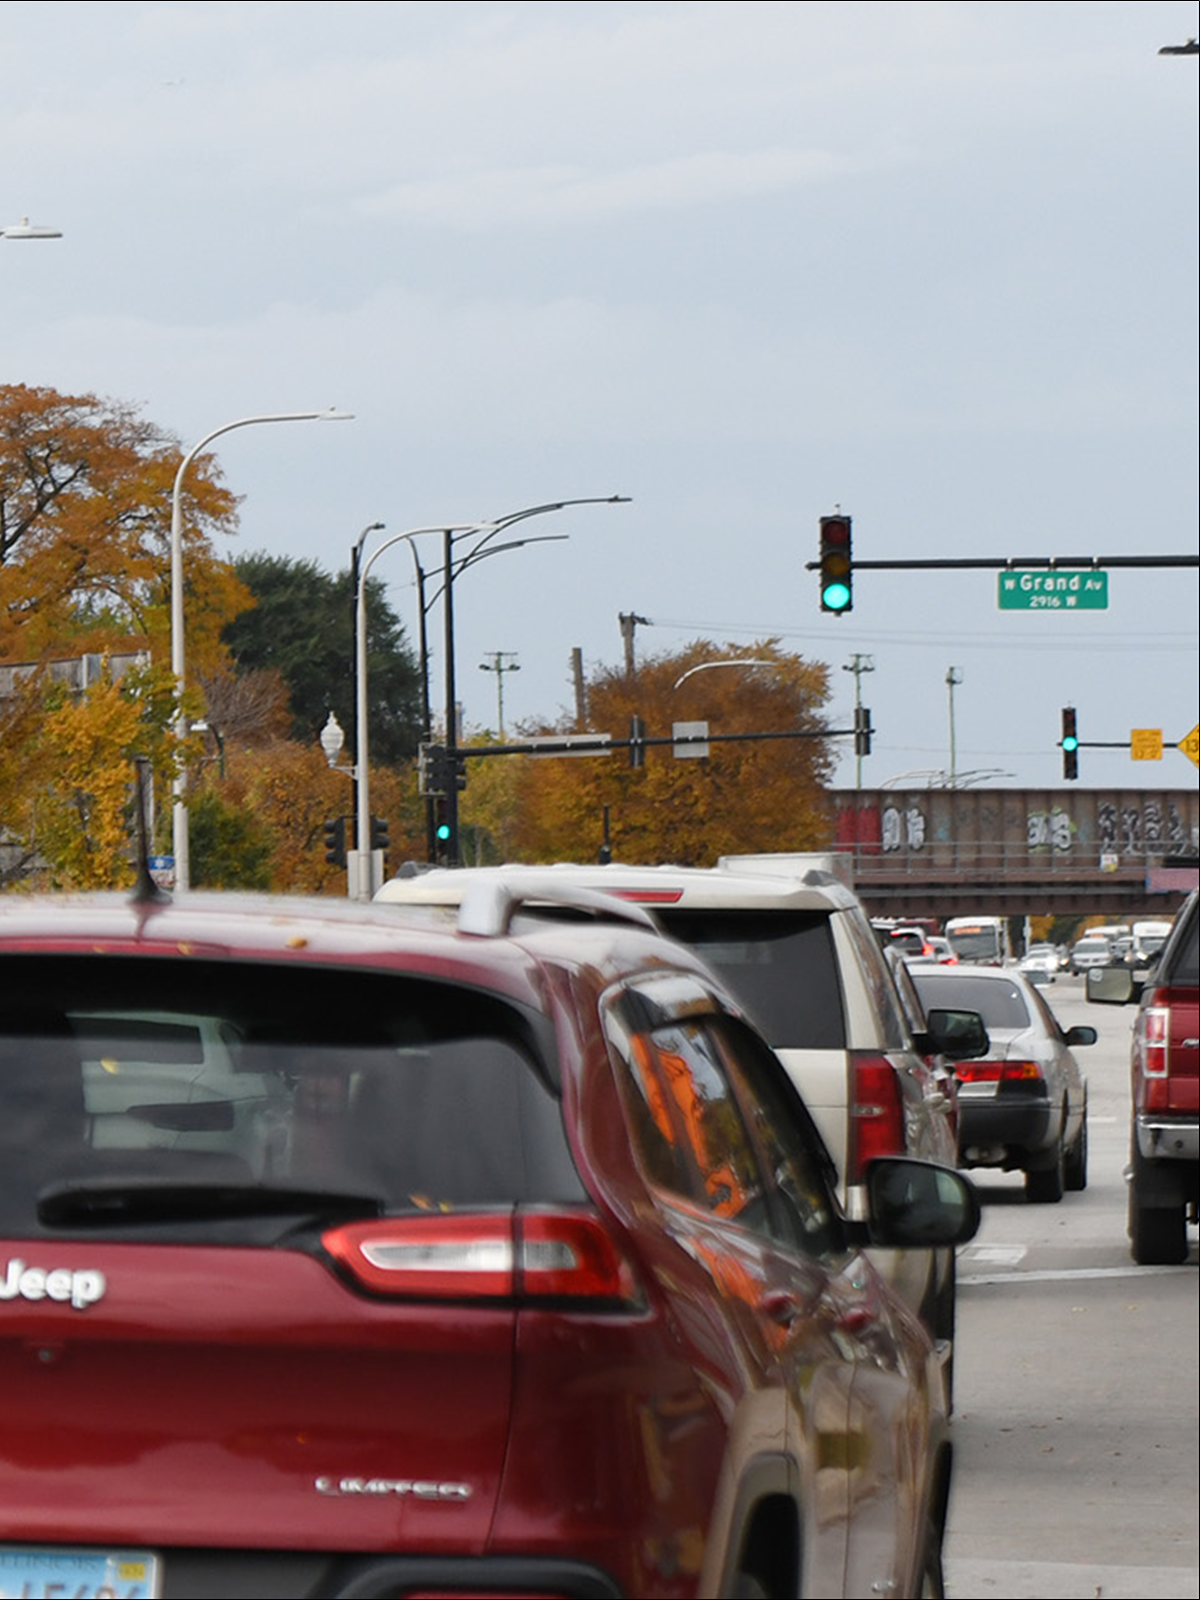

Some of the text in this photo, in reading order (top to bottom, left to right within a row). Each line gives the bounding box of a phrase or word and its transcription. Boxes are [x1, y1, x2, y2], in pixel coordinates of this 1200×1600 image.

[1004, 574, 1102, 591] W Grand Av
[1029, 595, 1077, 607] 2916 W
